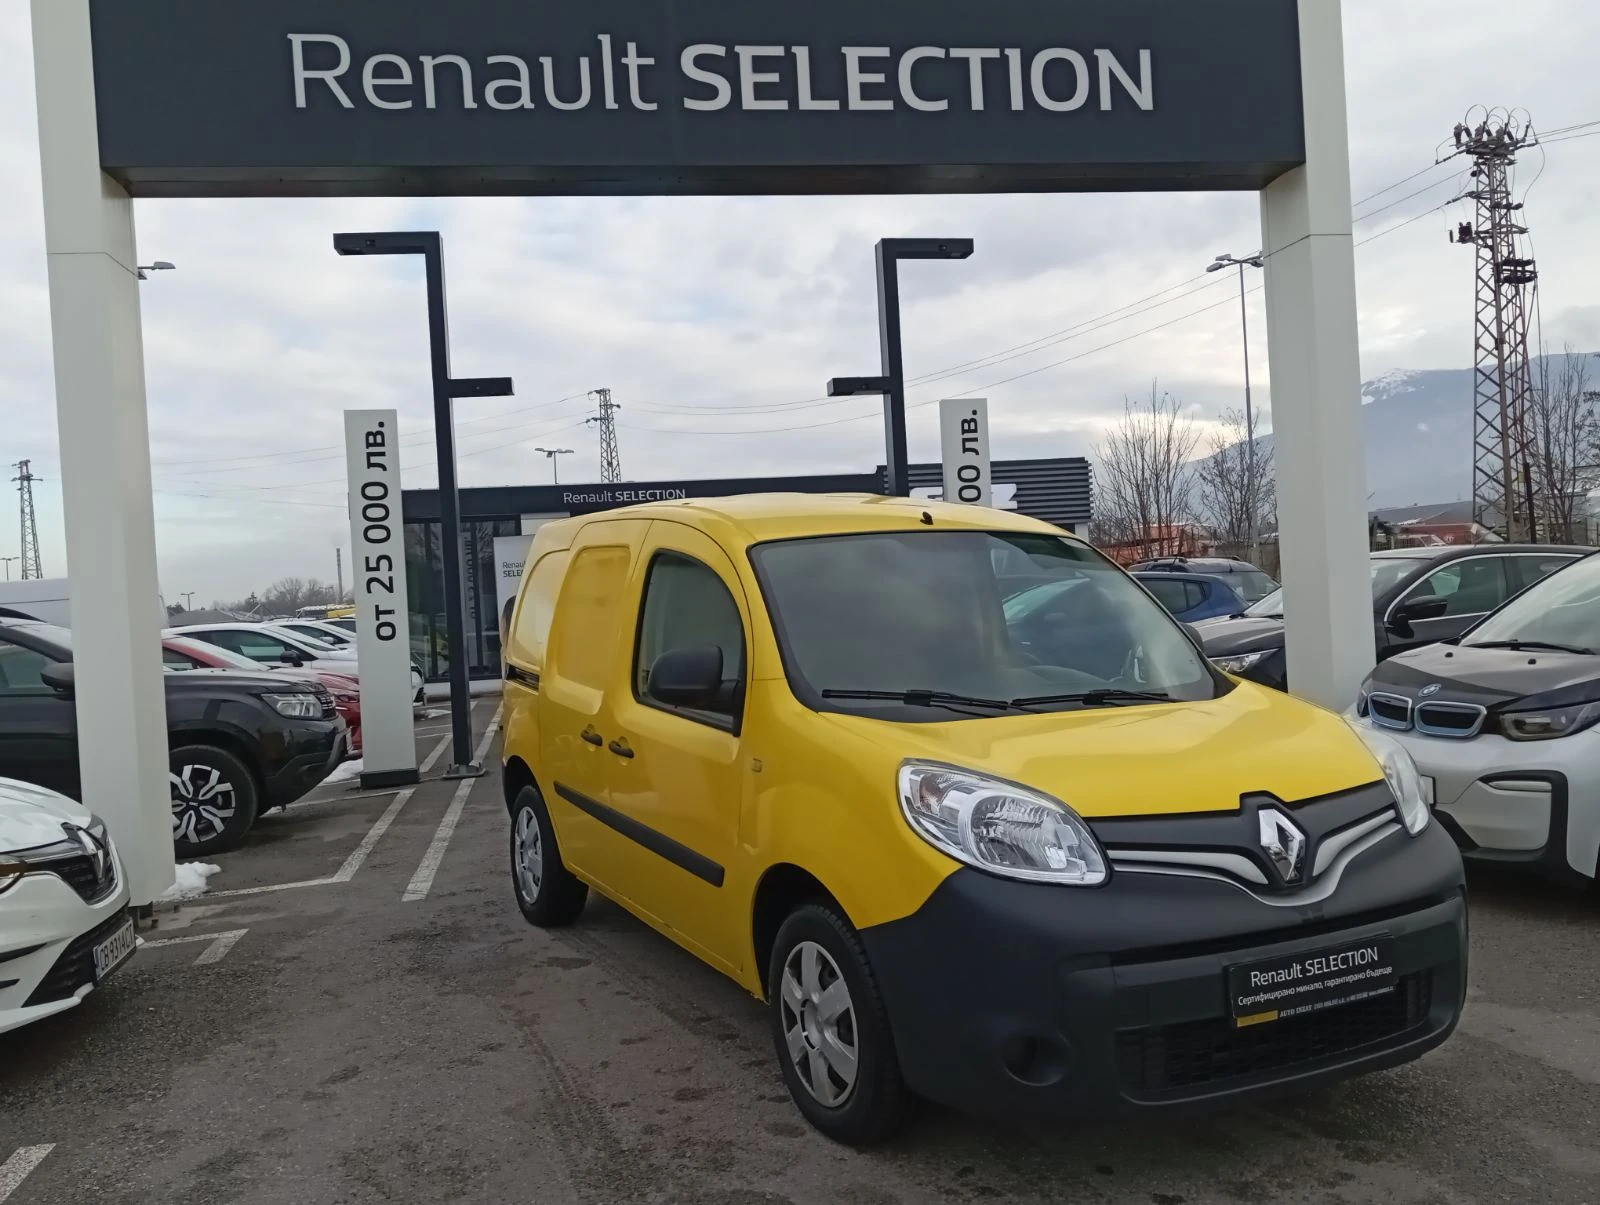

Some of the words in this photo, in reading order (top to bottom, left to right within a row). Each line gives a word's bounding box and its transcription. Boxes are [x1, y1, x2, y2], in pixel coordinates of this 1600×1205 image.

[287, 33, 658, 110] Renault
[680, 44, 1154, 112] SELECTION
[365, 421, 387, 471] лв.
[961, 409, 979, 455] лв.
[361, 481, 391, 544] 000
[563, 491, 612, 503] Renault
[615, 489, 686, 501] SELECTION
[365, 554, 394, 594] 25
[375, 604, 397, 641] от
[1251, 963, 1303, 987] Renault
[1305, 947, 1378, 976] SELECTION
[1238, 988, 1295, 1006] Сертифицирано
[1296, 983, 1323, 995] минало,
[1324, 974, 1366, 988] гарантирано
